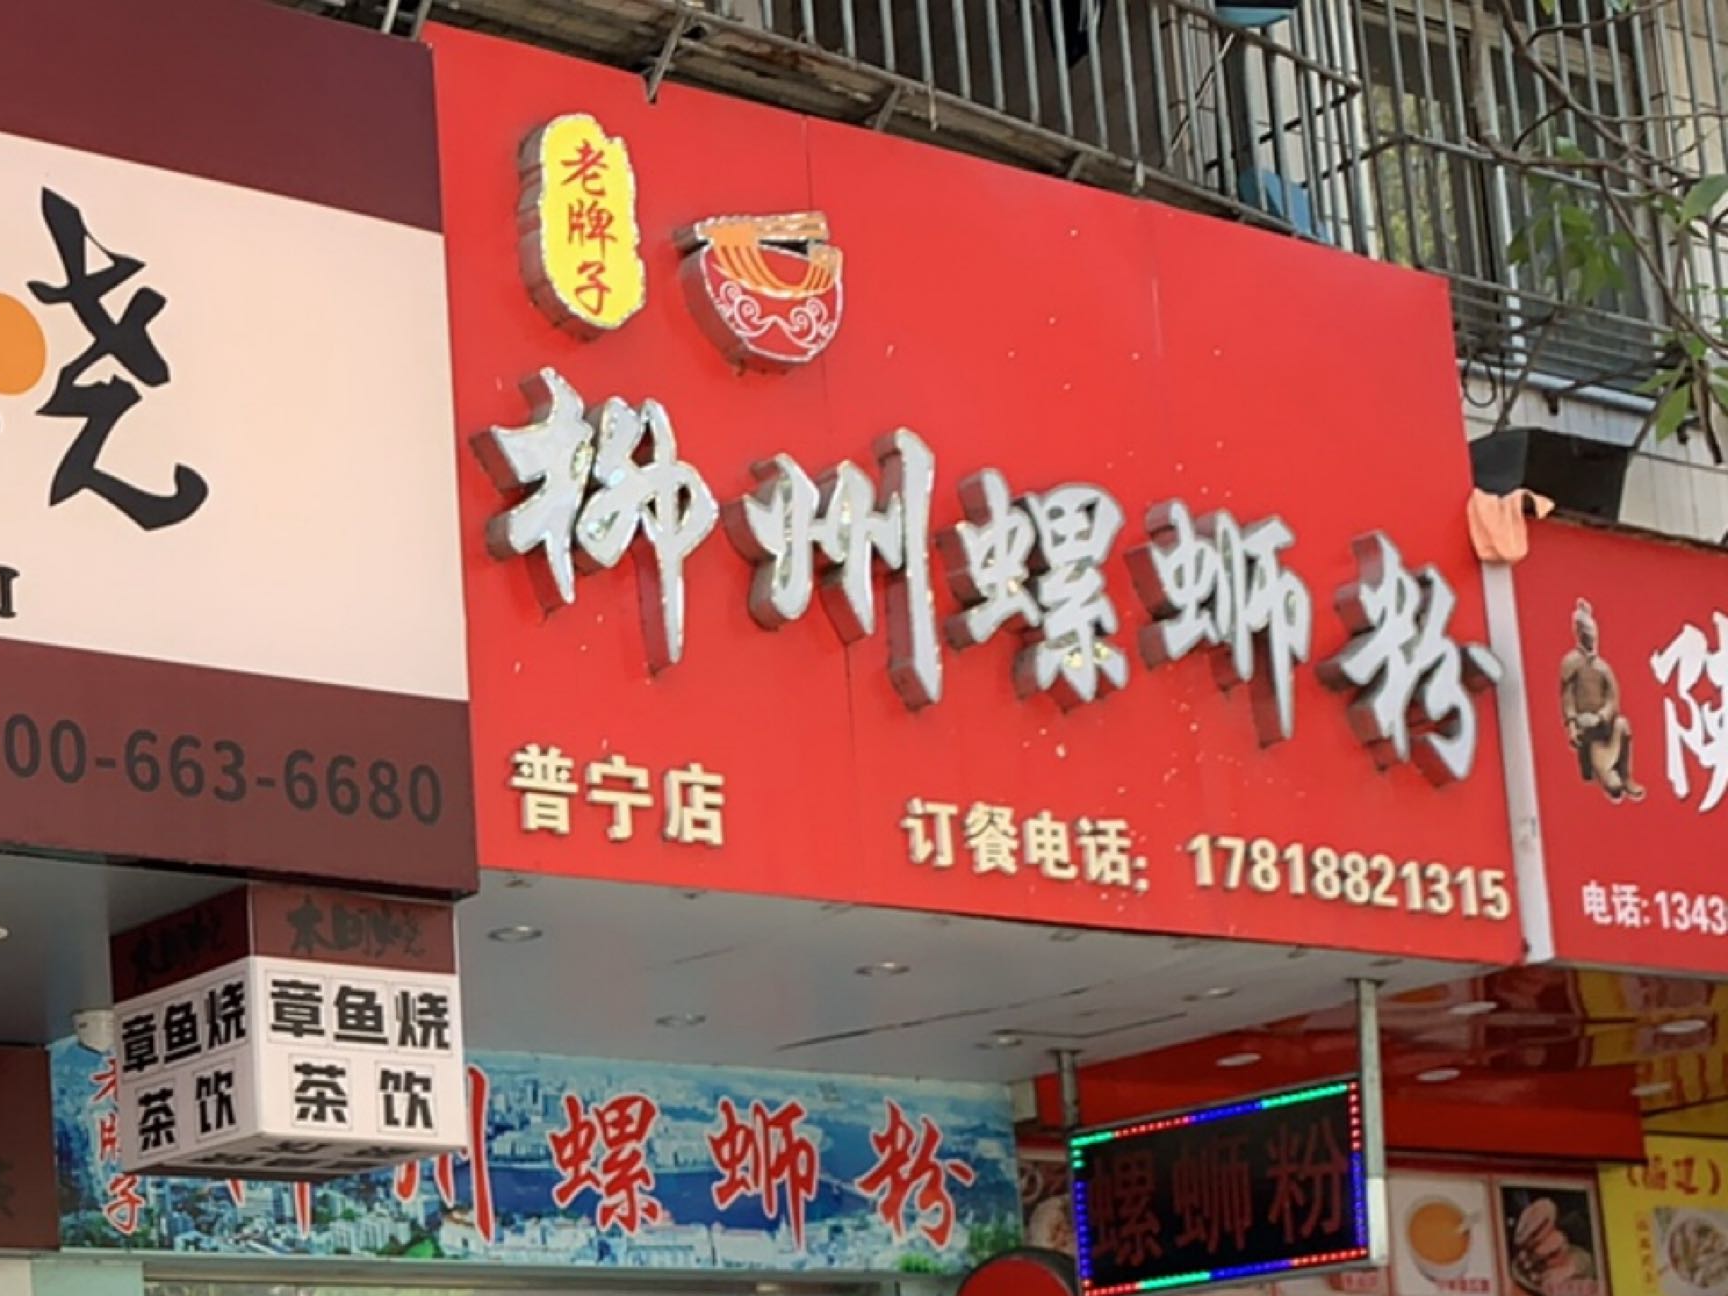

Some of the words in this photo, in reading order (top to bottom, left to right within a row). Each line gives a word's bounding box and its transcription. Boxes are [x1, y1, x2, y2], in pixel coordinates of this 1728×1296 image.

[557, 140, 618, 317] 老牌子
[472, 366, 1502, 788] 柳州螺蛳粉
[510, 744, 726, 848] 普宁店
[1188, 830, 1512, 922] 17818821315
[121, 980, 247, 1074] 章鱼烧
[270, 979, 451, 1051] 章鱼烧
[137, 1069, 237, 1151] 茶饮
[293, 1062, 433, 1130] 茶饮
[227, 1066, 980, 1249] 州螺蛳粉
[1090, 1117, 1349, 1267] 螺蛳粉
